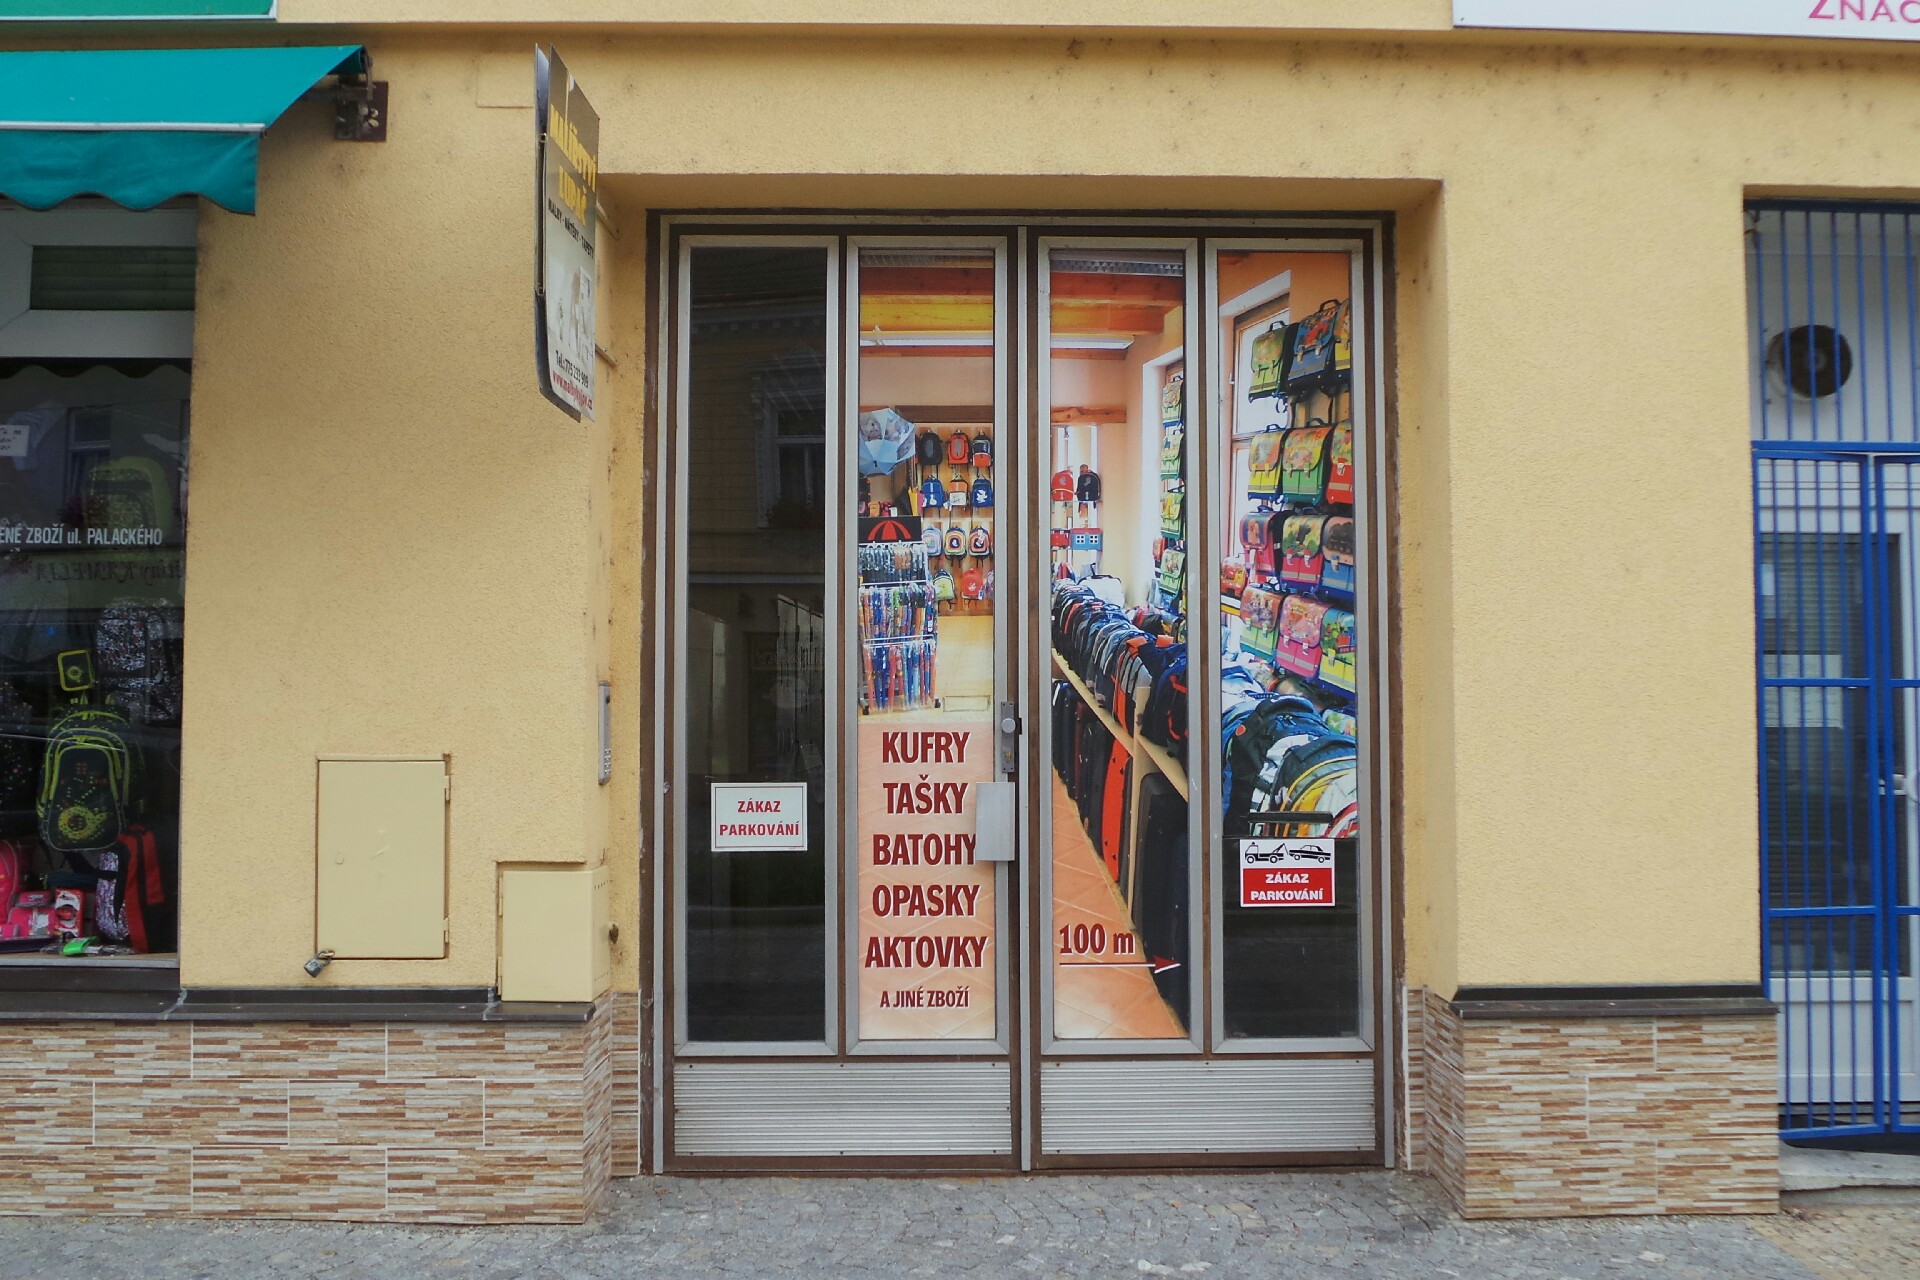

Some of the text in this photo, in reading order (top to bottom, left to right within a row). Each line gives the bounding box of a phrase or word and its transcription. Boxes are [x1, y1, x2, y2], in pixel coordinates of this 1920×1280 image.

[26, 523, 64, 544] ZBOŽÍ
[67, 529, 81, 545] ul.
[87, 524, 163, 546] PALACKÉHO
[882, 731, 970, 763] KUFRY
[737, 798, 781, 813] ZÁKAZ
[883, 774, 968, 814] TAŠKY
[719, 820, 800, 836] PARKOVÁNÍ
[873, 833, 976, 865] BATOHY
[1265, 871, 1309, 884] ZÁKAZ
[872, 884, 980, 917] OPASKY
[1251, 887, 1323, 901] PARKOVÁNÍ
[864, 935, 988, 969] AKTOVKY
[1059, 924, 1135, 954] 100 m
[879, 986, 969, 1008] A JINÉ ZBOŽÍ
